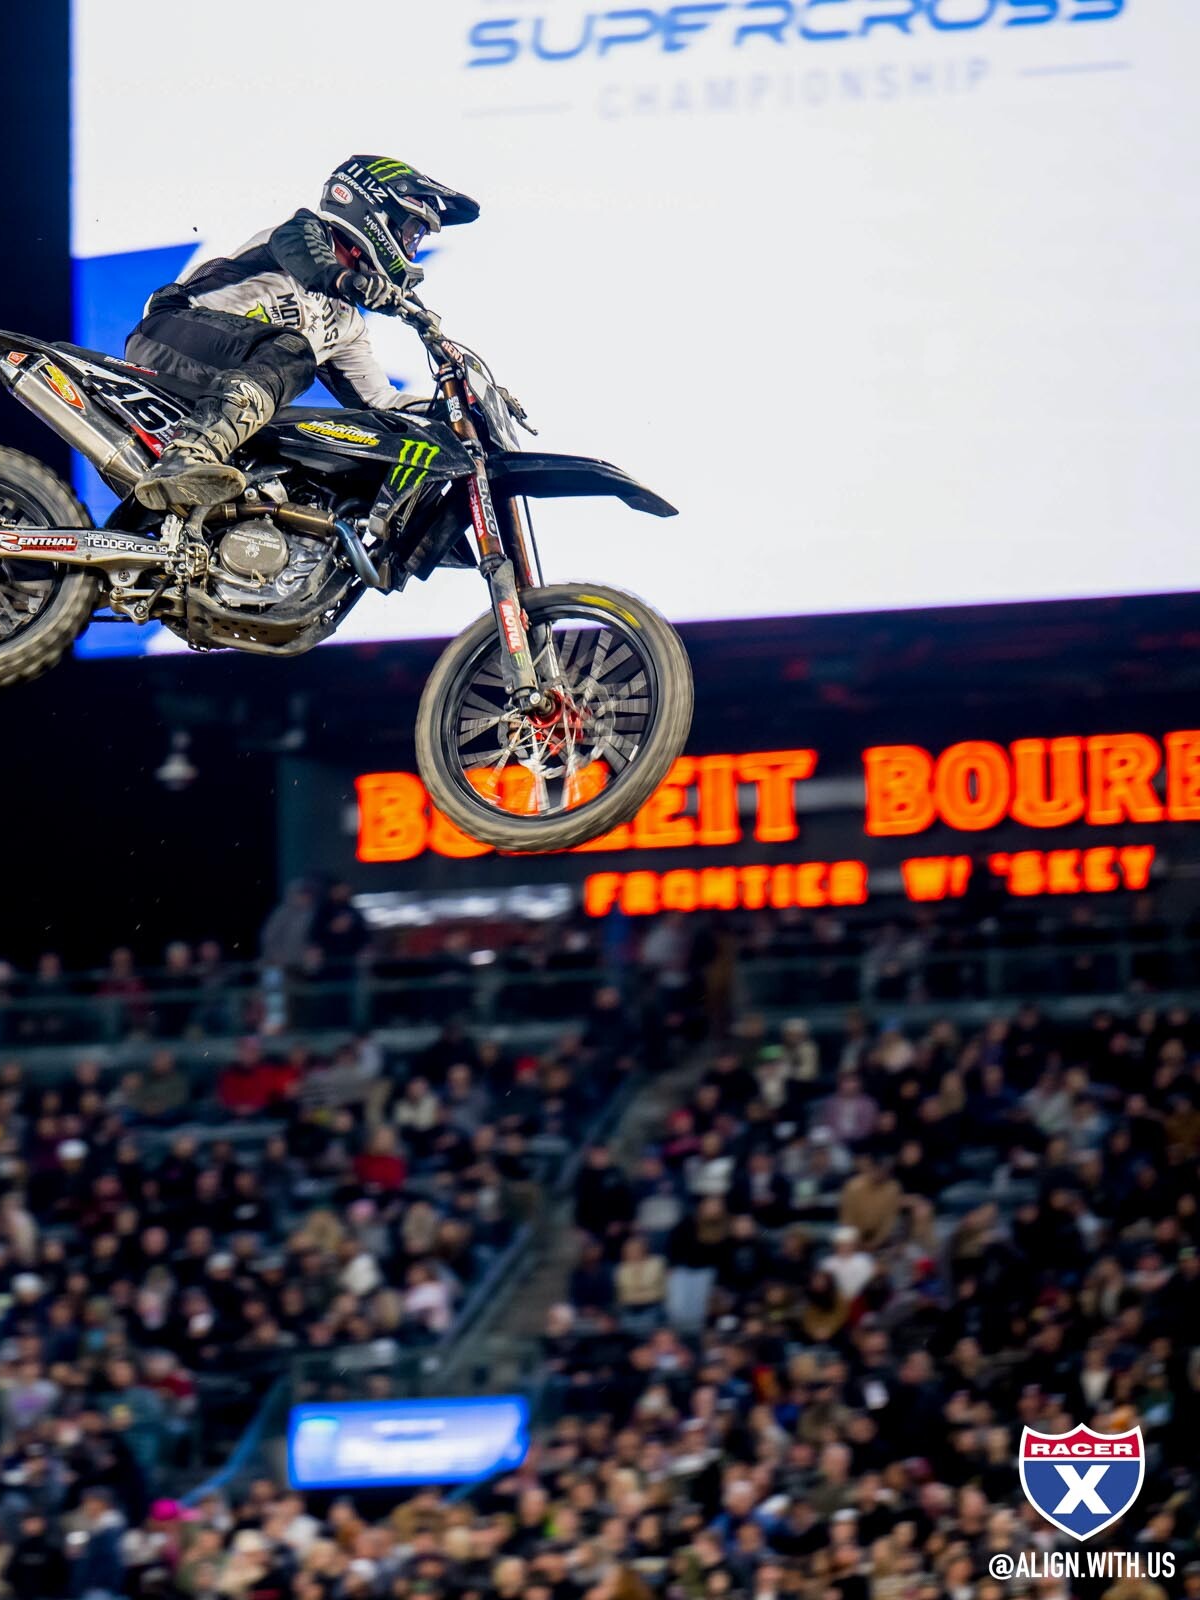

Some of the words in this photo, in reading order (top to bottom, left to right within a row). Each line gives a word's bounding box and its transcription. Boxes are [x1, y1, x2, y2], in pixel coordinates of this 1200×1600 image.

[599, 57, 991, 121] CHAMPIONSHIP
[334, 186, 349, 201] BELL
[363, 215, 398, 259] MONSTER
[297, 422, 380, 446] MOTORSPORTS
[308, 420, 379, 438] MOUNTAIN
[477, 477, 498, 536] ENZO
[501, 604, 521, 650] MOTUL
[583, 859, 868, 918] FRONTIER
